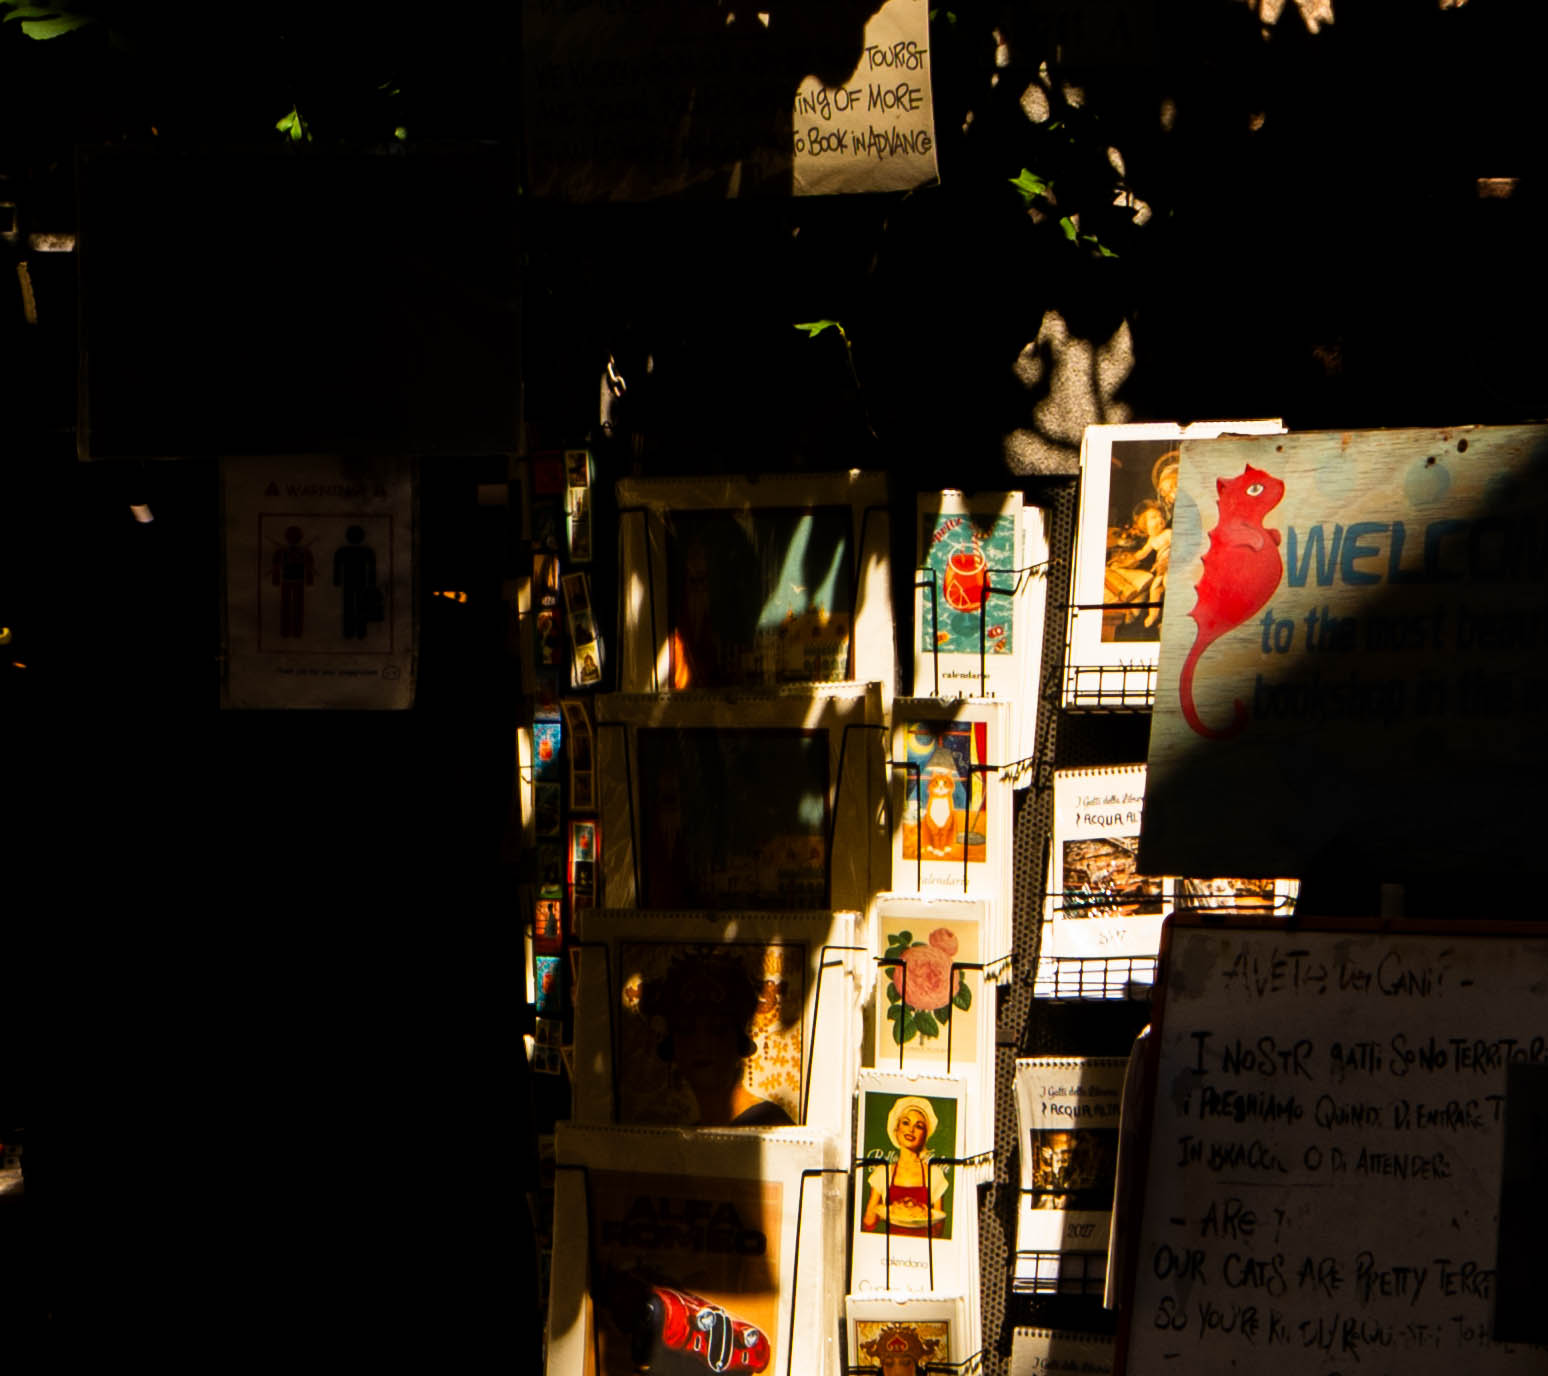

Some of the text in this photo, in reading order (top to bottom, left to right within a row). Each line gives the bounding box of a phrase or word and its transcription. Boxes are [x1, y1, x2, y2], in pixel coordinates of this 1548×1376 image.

[834, 87, 862, 113] OF
[867, 84, 923, 113] MORE
[808, 128, 849, 157] BOOK
[1260, 609, 1295, 654] to
[1304, 607, 1359, 653] the
[1364, 607, 1445, 653] most
[1252, 673, 1403, 725] bookshop
[1414, 670, 1446, 718] in
[1455, 669, 1513, 716] the
[1050, 1102, 1091, 1119] ACQUA
[1153, 1244, 1207, 1285] OUR
[1223, 1251, 1289, 1298] CATS
[1297, 1257, 1345, 1299] ARE
